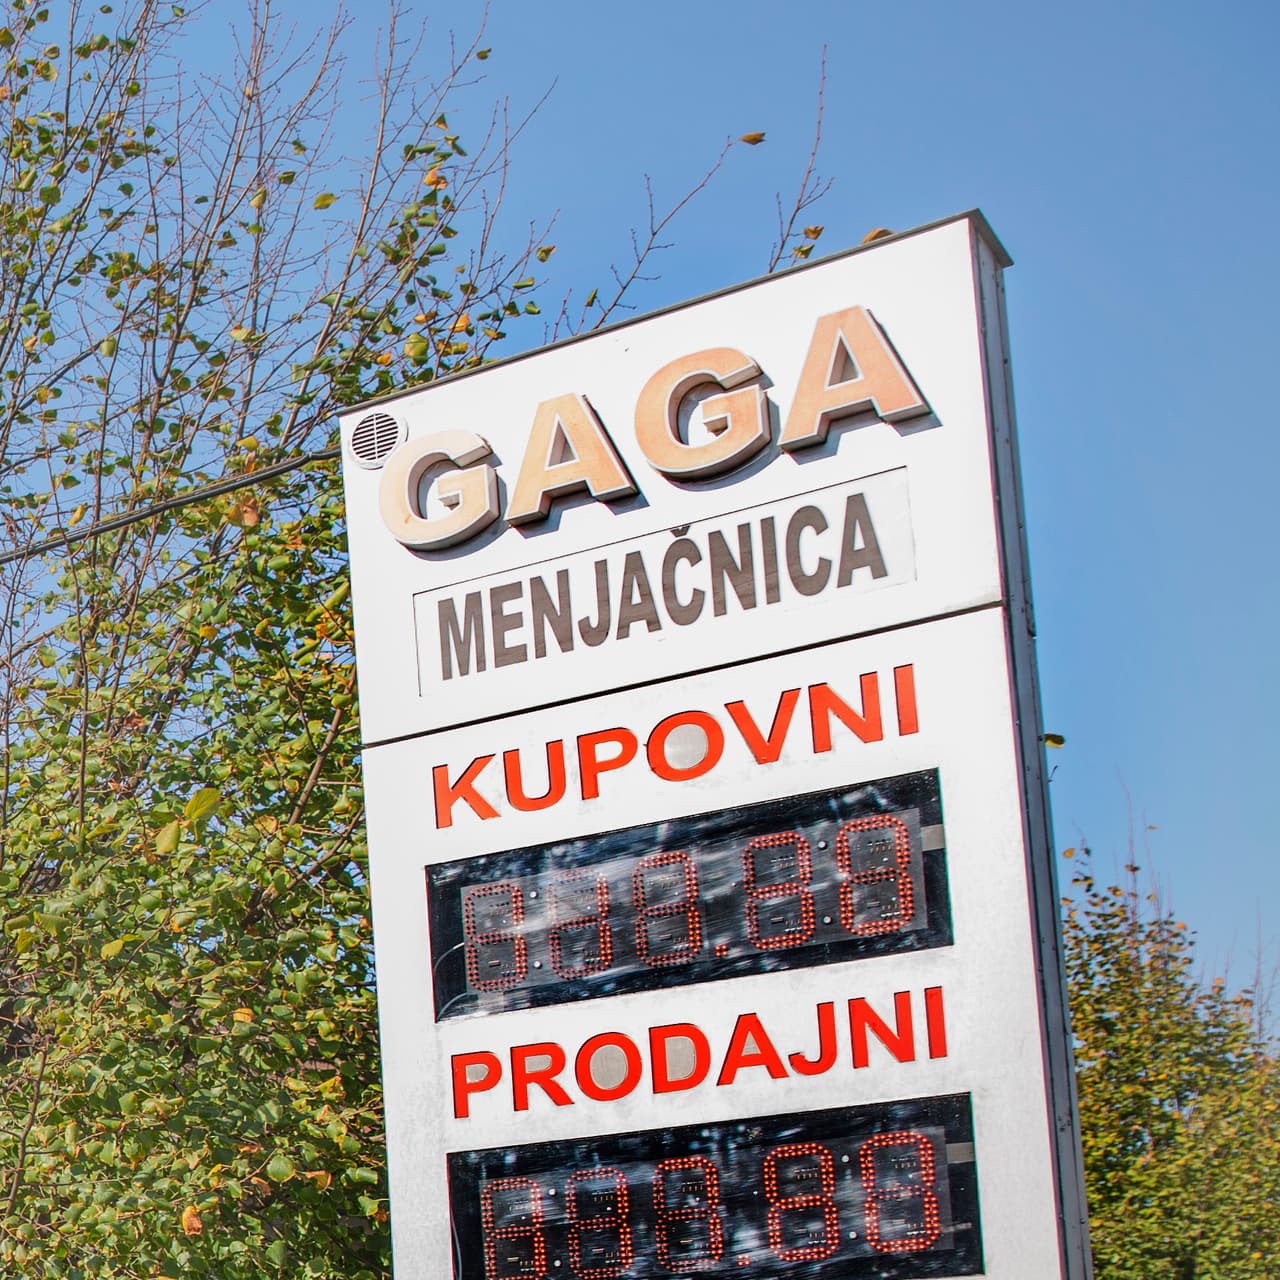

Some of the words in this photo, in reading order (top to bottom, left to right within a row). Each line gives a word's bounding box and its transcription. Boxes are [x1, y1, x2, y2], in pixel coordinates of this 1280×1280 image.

[378, 305, 933, 554] GAGA
[437, 492, 889, 681] MENJAČNICA
[432, 664, 921, 830] KUPOVNI
[451, 986, 948, 1119] PRODAJNI
